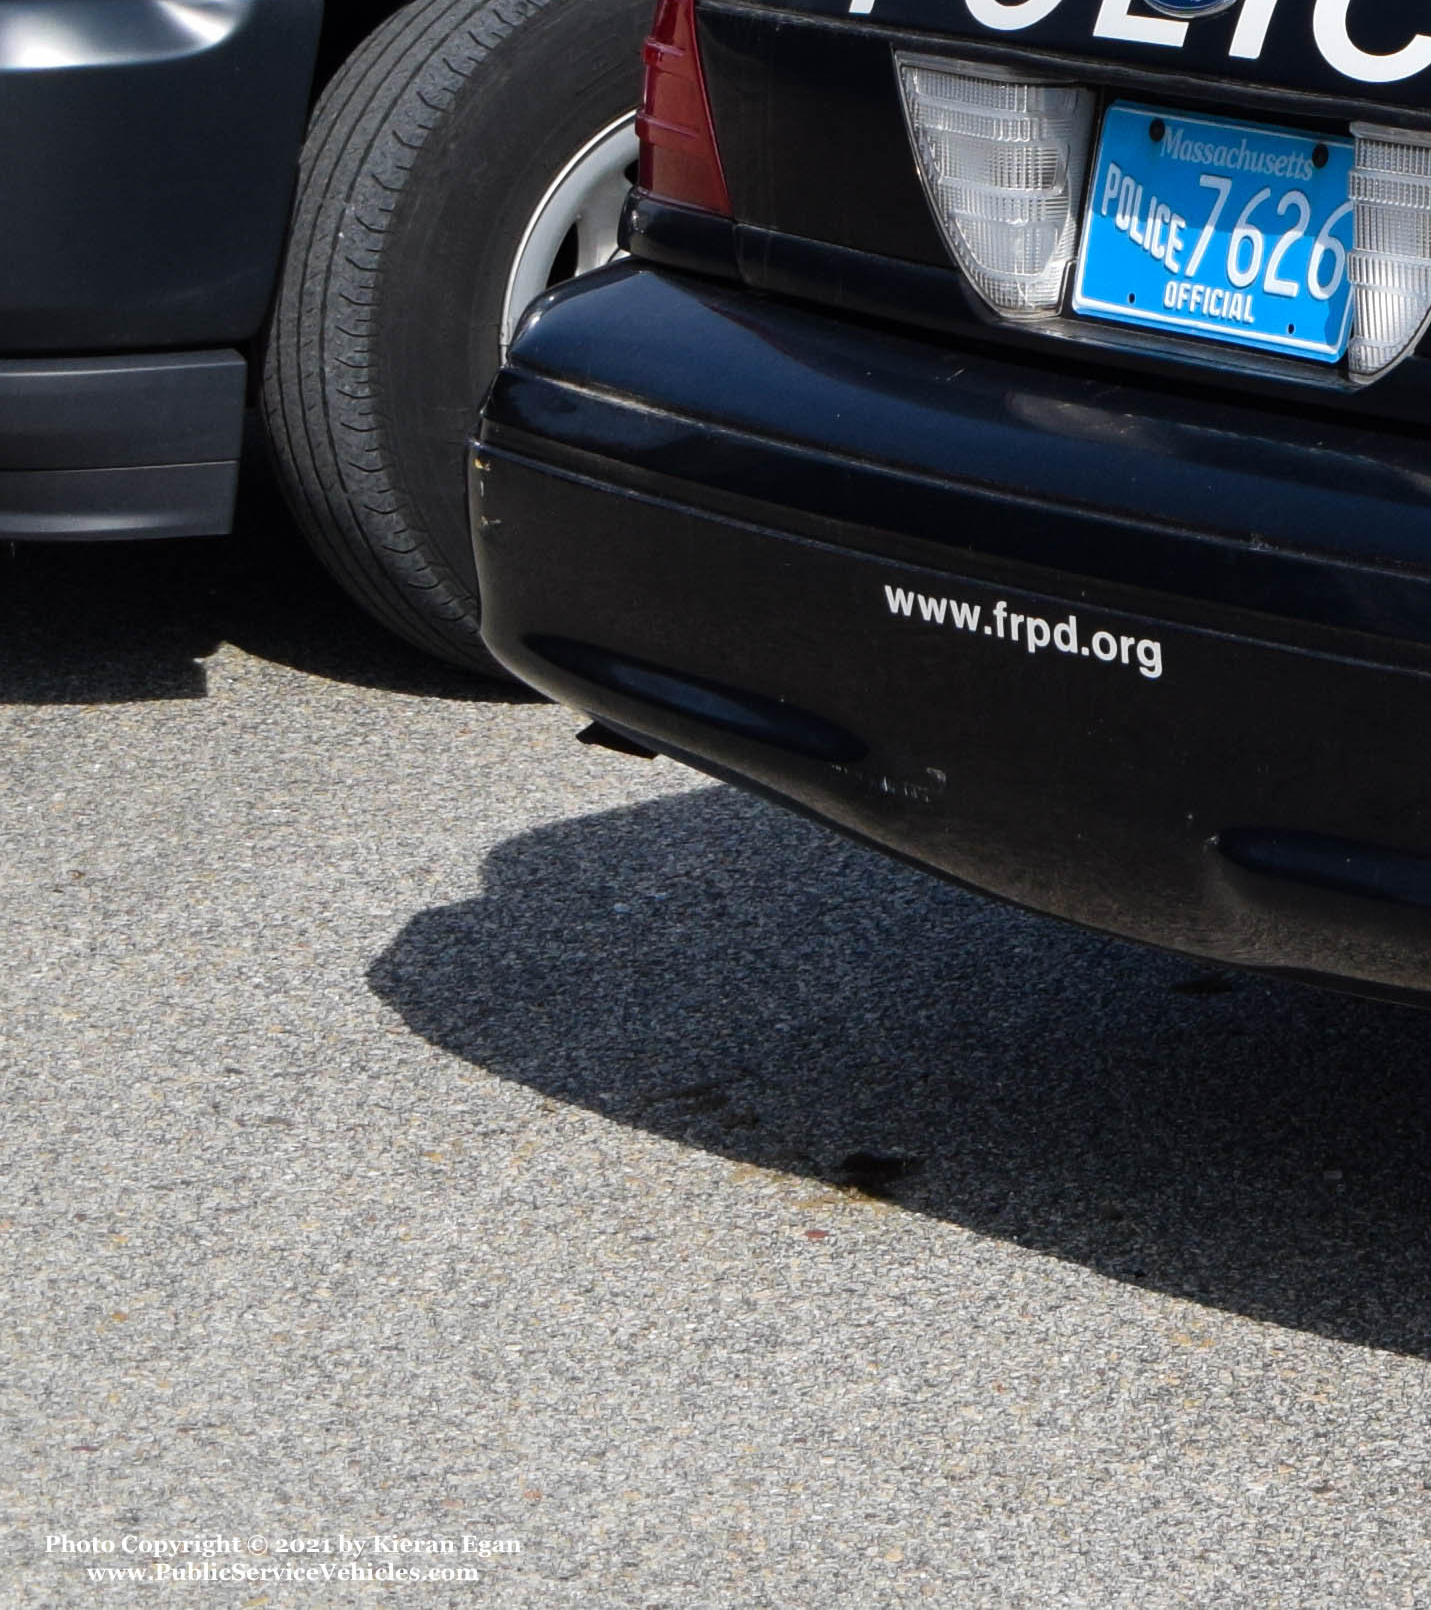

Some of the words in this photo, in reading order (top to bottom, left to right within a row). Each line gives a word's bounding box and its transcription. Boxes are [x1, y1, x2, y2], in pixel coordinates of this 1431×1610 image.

[1159, 124, 1315, 182] Massachusetts
[1100, 162, 1187, 274] POLICE
[1184, 173, 1354, 301] 7626
[1162, 280, 1256, 324] OFFICIAL
[884, 584, 1163, 679] www.frpd.org
